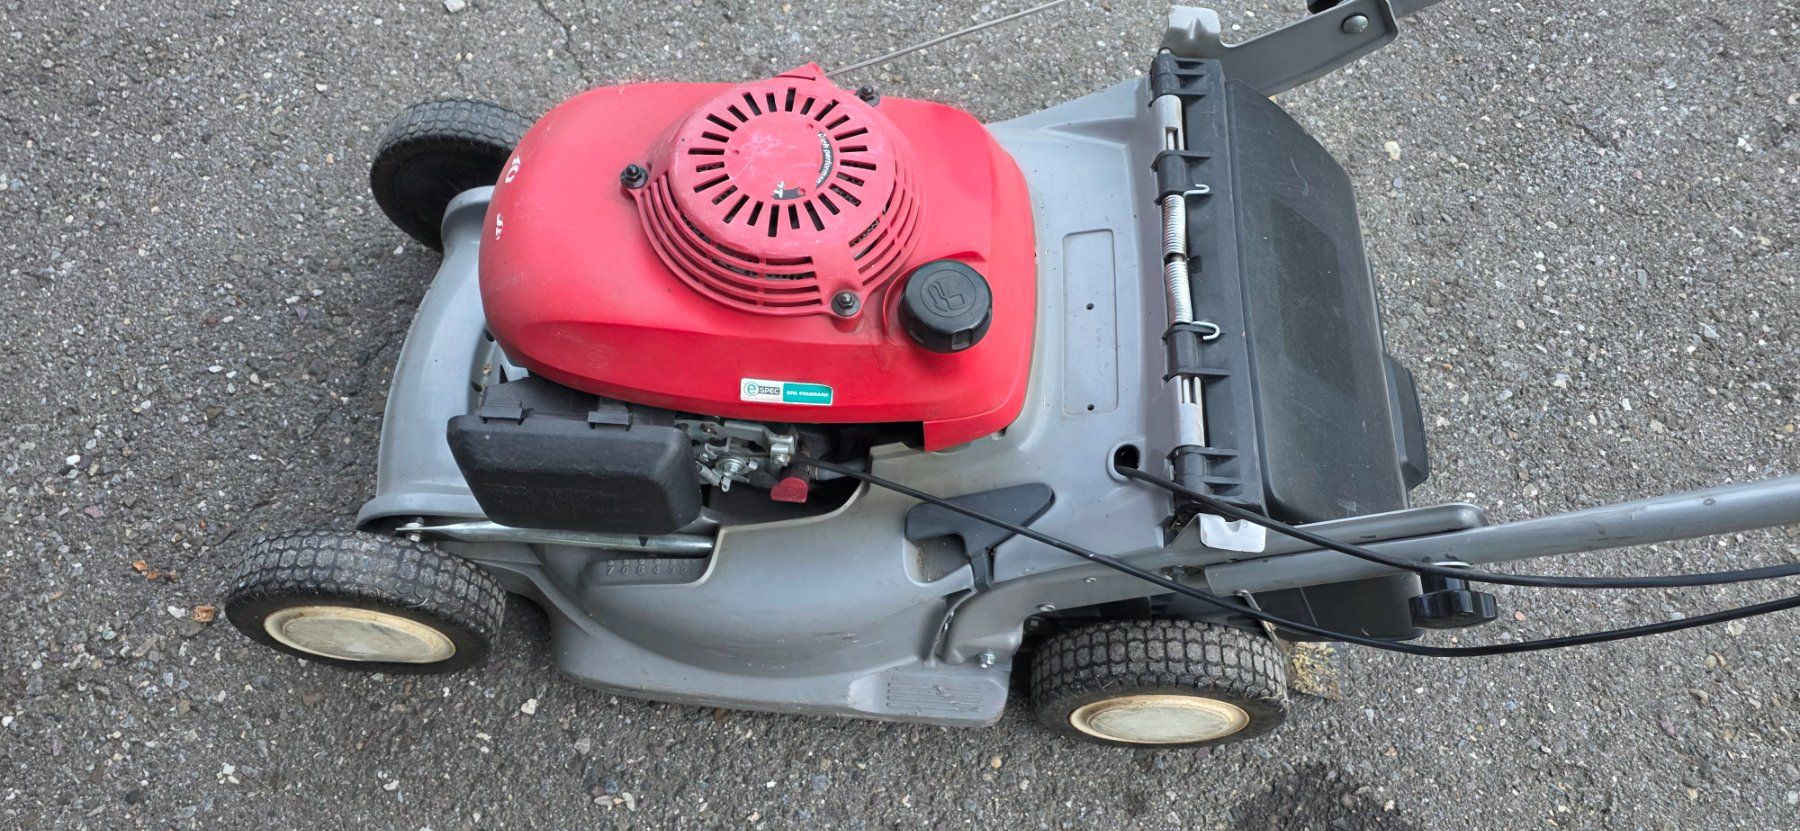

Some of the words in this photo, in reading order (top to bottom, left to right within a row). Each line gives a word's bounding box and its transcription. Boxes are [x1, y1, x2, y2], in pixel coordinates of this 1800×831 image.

[759, 386, 780, 395] SPEC
[798, 390, 829, 398] STANDARD
[607, 565, 615, 576] 7
[622, 565, 629, 575] 6
